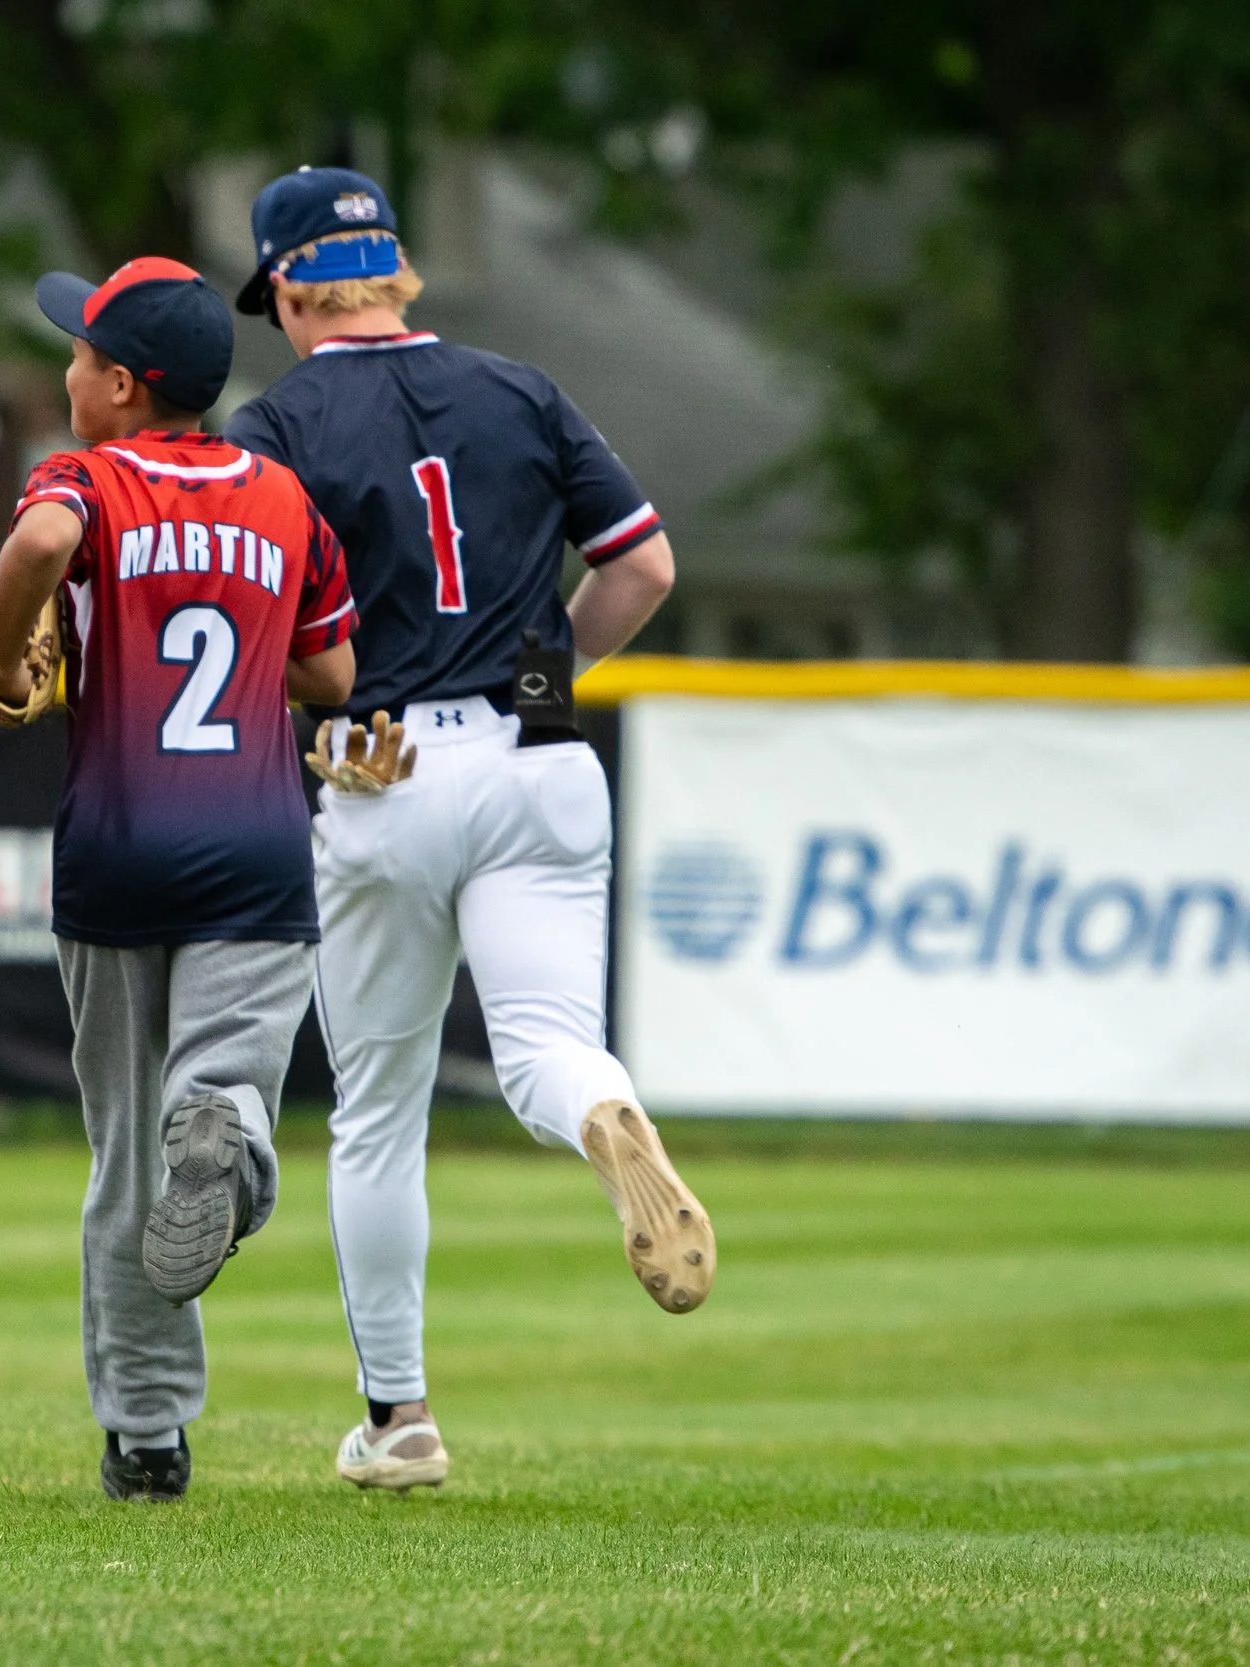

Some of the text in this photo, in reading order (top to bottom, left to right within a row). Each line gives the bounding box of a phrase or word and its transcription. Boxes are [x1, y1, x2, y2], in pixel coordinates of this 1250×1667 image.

[117, 520, 284, 597] MARTIN
[410, 455, 468, 614] 1
[156, 601, 240, 755] 2
